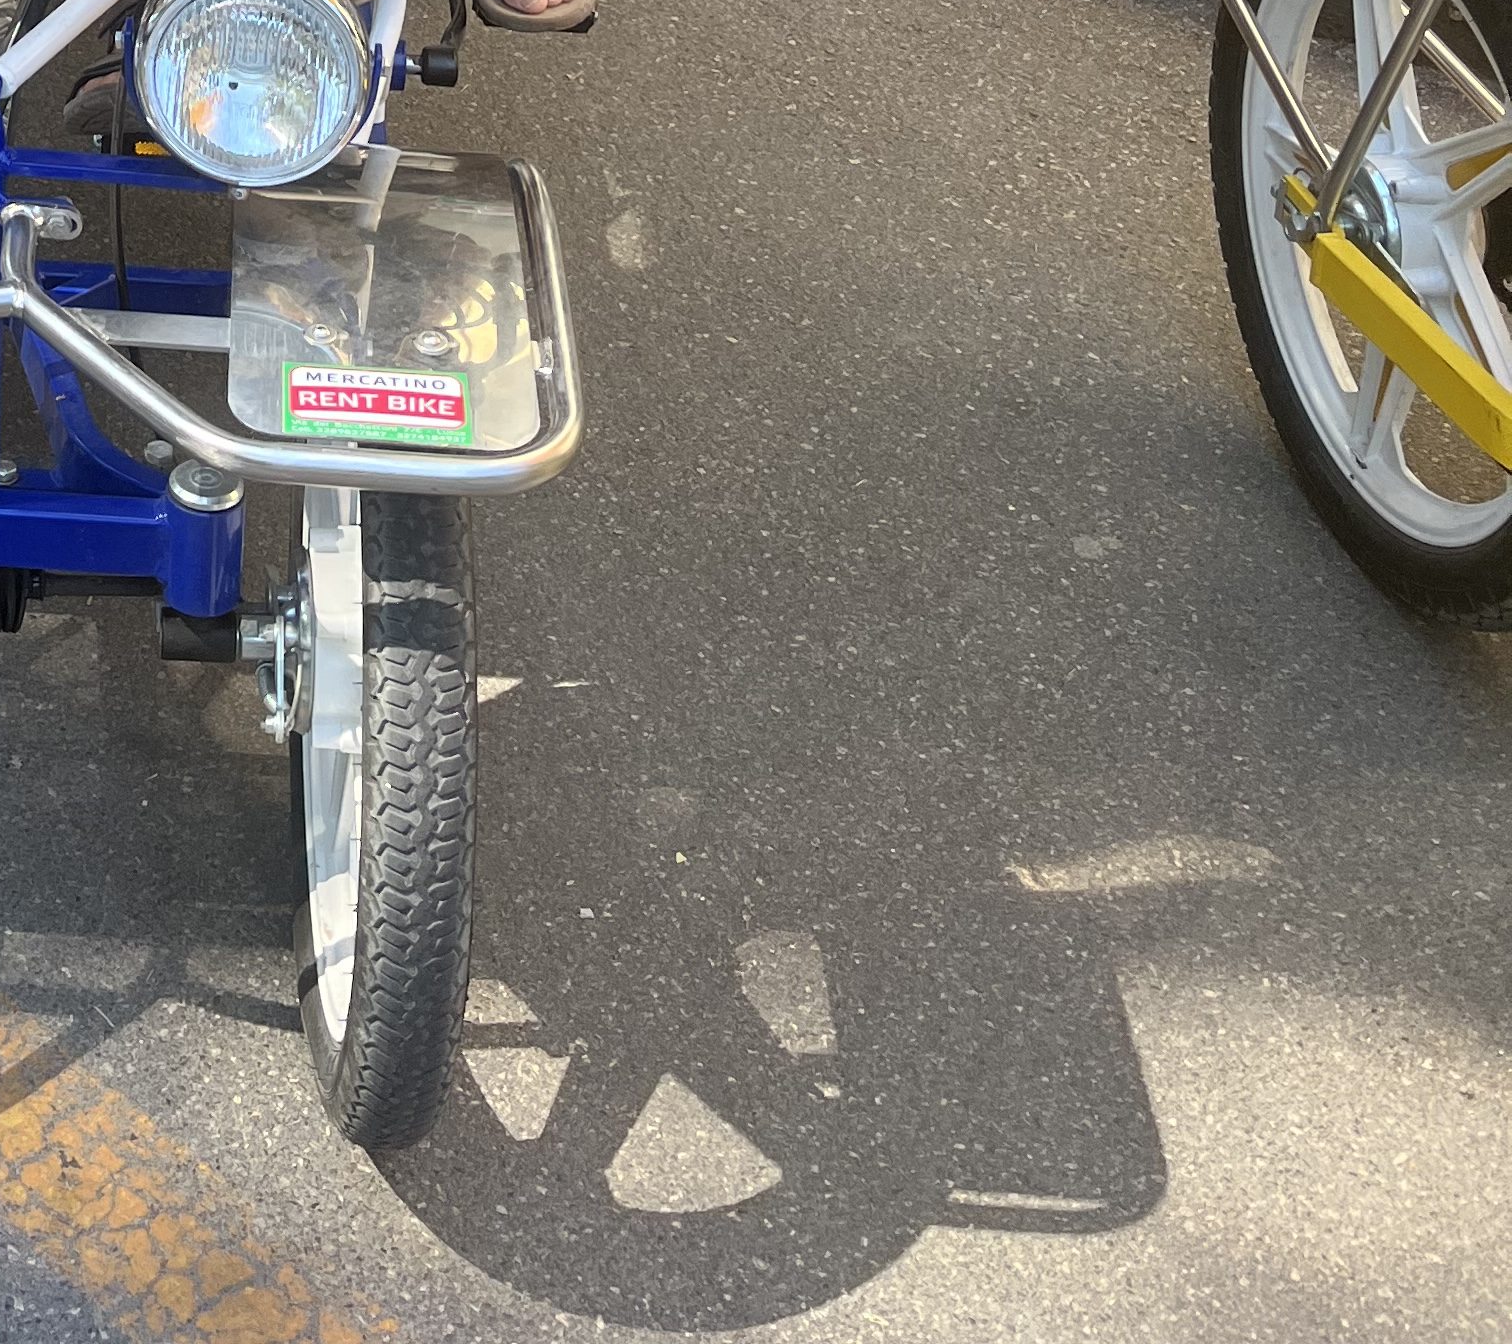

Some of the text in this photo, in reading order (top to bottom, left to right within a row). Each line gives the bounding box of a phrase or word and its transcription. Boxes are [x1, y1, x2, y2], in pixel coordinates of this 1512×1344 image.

[306, 372, 446, 390] MERCATINO
[298, 390, 456, 416] RENT BIKE
